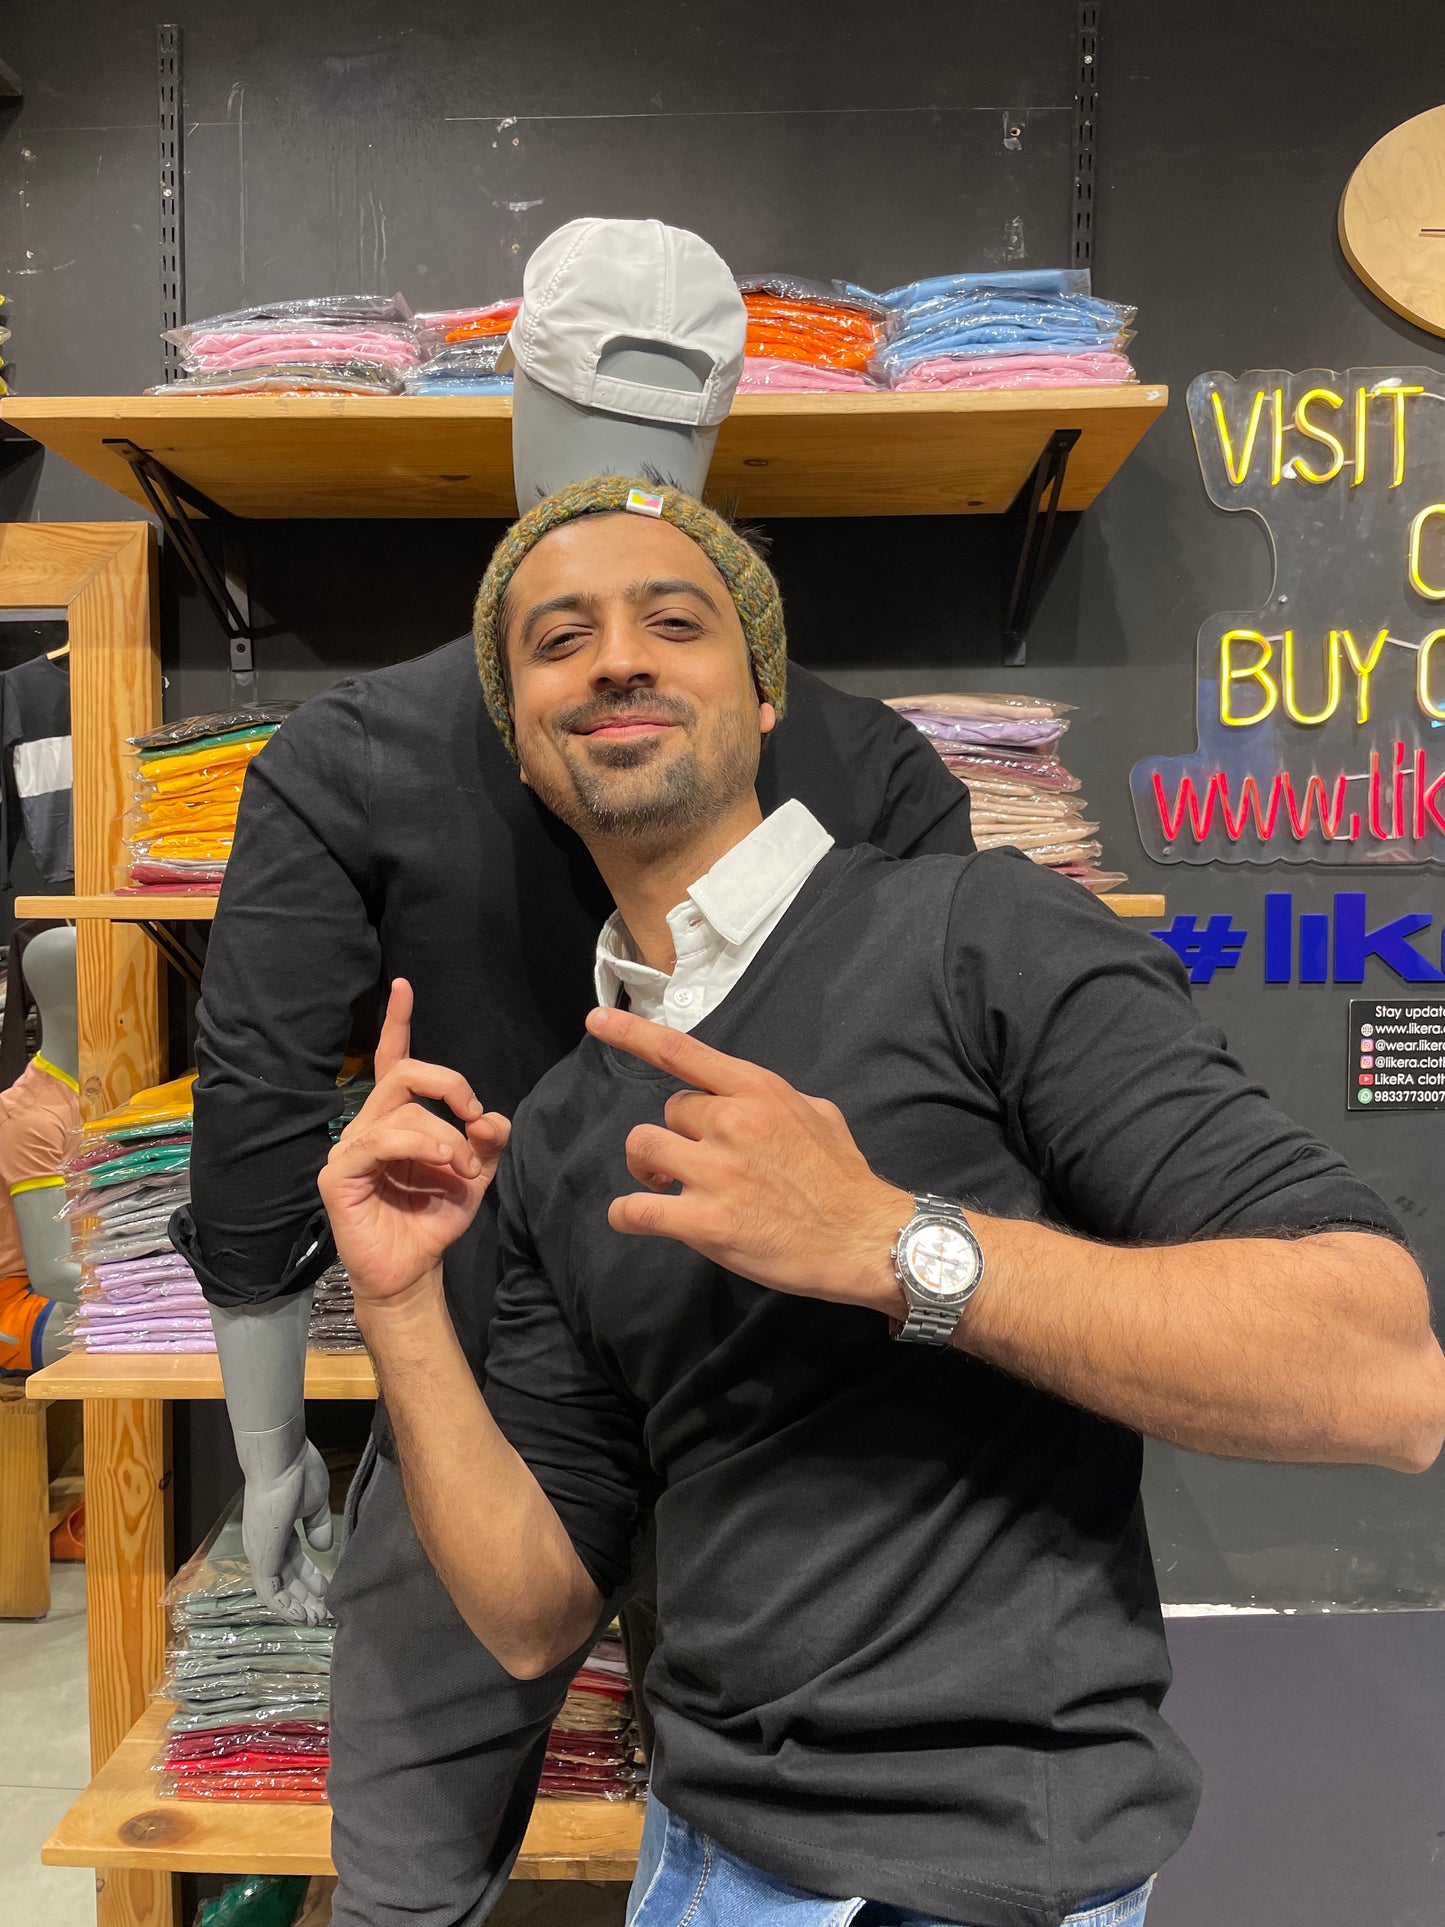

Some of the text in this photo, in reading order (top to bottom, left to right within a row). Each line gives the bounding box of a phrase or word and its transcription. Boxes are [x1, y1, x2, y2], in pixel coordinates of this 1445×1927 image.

[1211, 386, 1425, 487] VISIT
[1220, 628, 1389, 726] BUY
[1150, 892, 1445, 983] #lik
[1375, 1005, 1402, 1020] Stay
[1374, 1091, 1445, 1102] 9833773007
[1375, 1073, 1414, 1085] LikeRA
